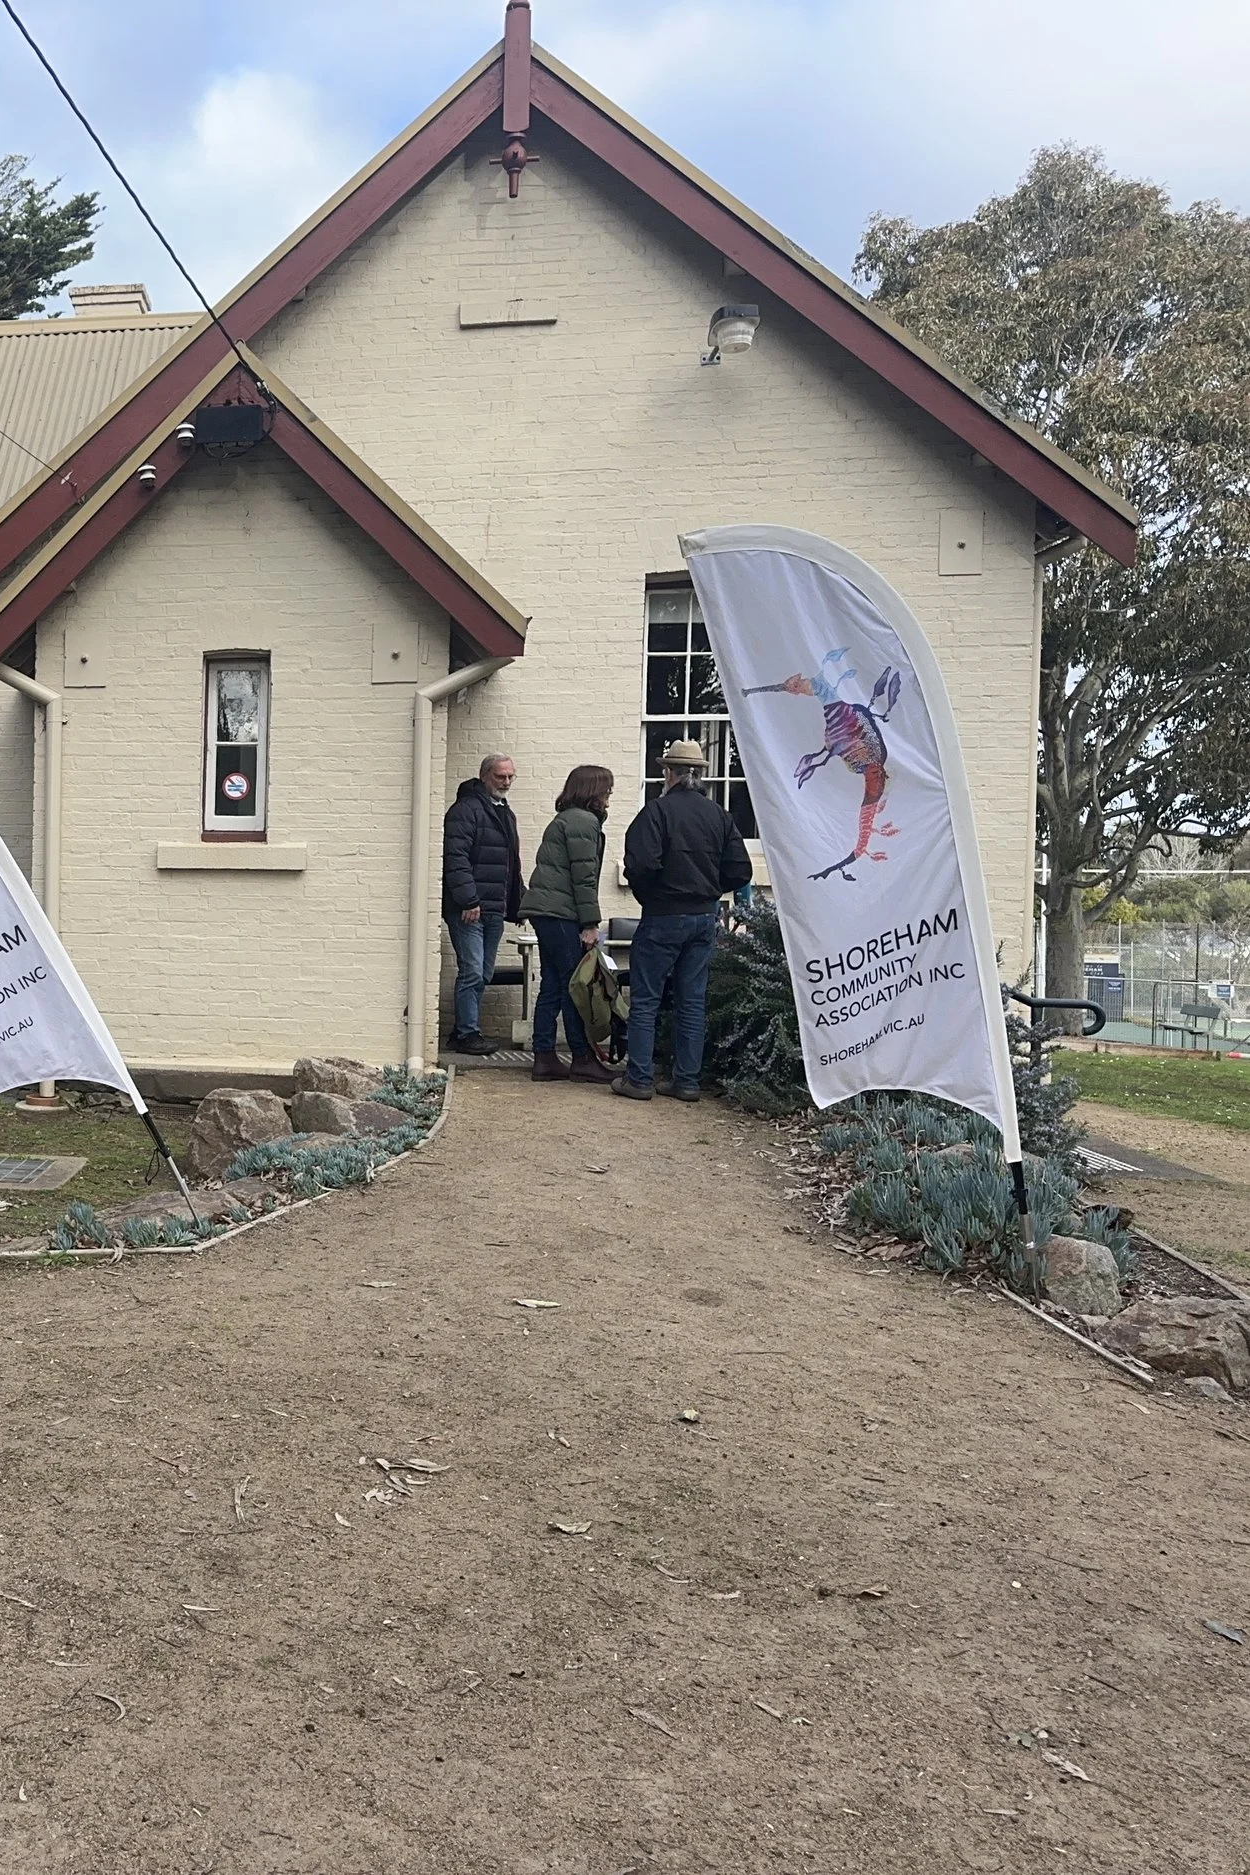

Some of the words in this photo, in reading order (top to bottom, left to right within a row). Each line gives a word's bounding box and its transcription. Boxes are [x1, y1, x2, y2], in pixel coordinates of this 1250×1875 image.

[806, 907, 959, 984] SHOREHAM
[17, 966, 47, 990] INC
[810, 953, 917, 1006] COMMUNITY
[814, 971, 924, 1028] ASSOCIATION
[928, 962, 966, 983] INC
